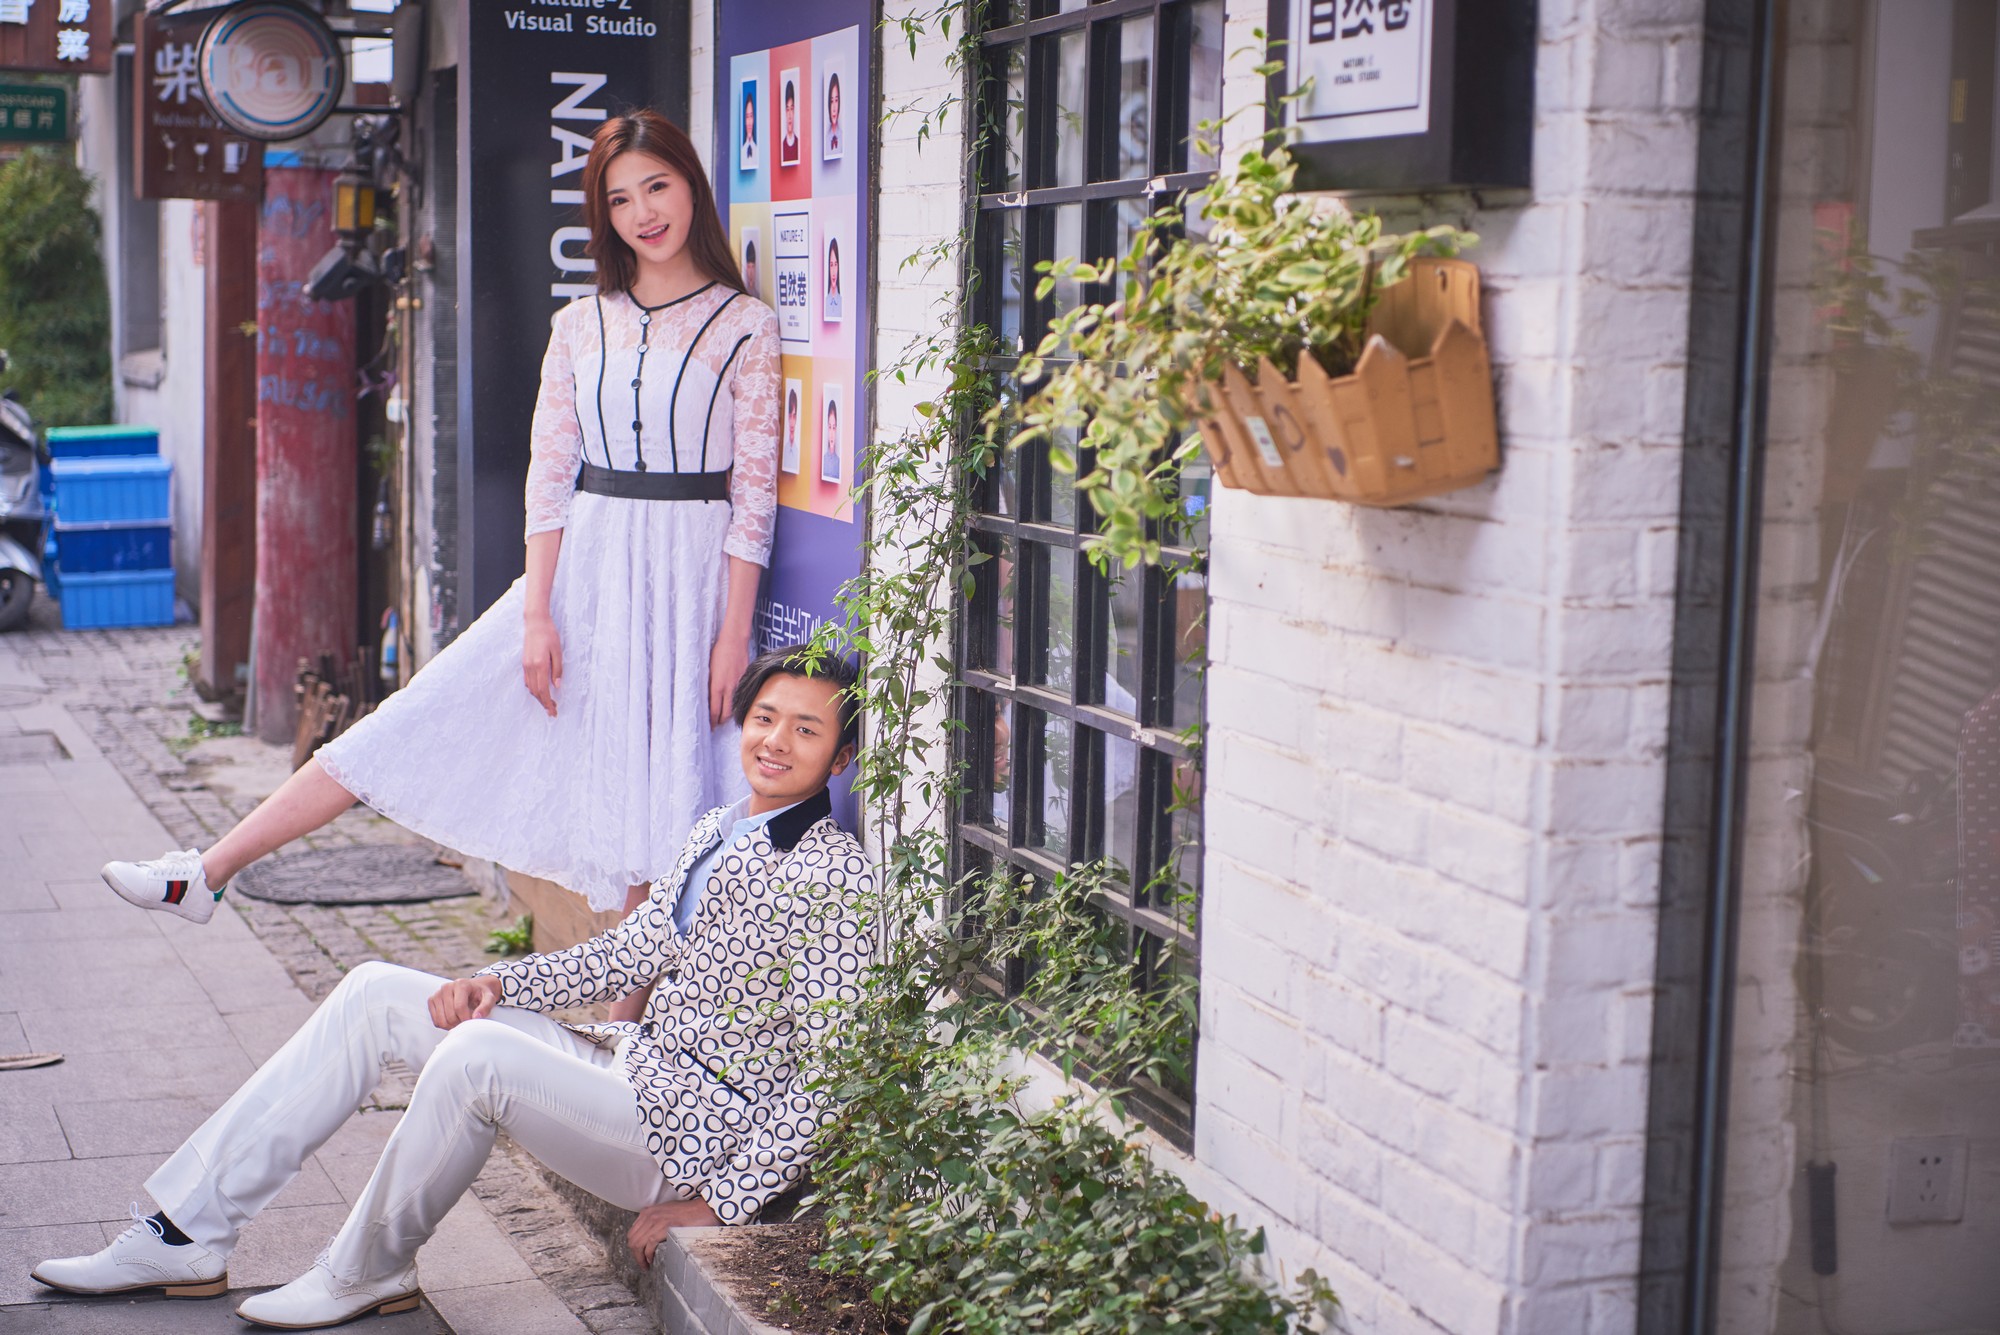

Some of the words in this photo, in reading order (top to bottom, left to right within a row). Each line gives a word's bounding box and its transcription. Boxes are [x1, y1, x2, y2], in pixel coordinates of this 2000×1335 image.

[531, 0, 632, 10] ure-Z
[504, 10, 573, 32] Visual
[586, 15, 657, 37] Studio
[212, 44, 338, 92] Bar
[779, 271, 807, 307] 自然卷
